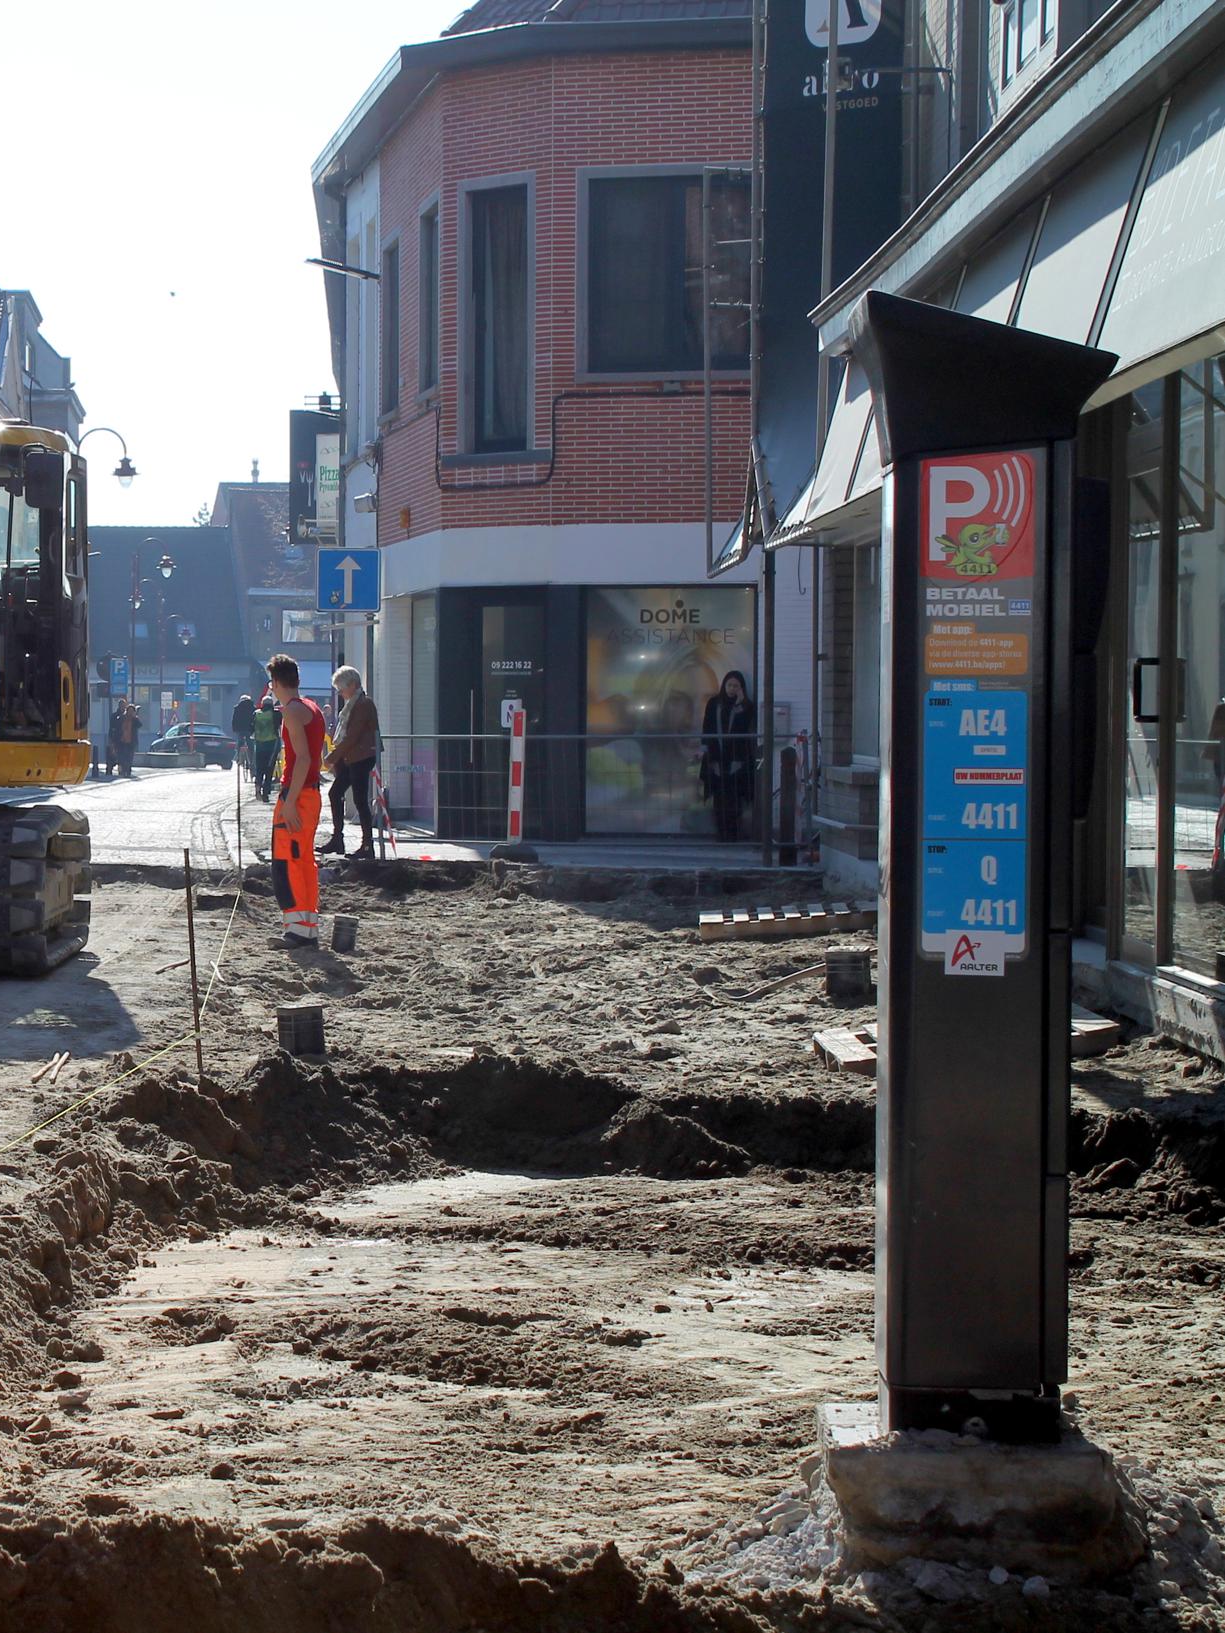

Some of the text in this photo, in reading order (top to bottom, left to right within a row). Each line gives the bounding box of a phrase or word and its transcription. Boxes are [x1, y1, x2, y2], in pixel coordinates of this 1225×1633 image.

[821, 97, 879, 112] VSTGOED
[960, 564, 993, 574] 4411
[926, 587, 1005, 600] BETAAL
[639, 608, 701, 624] DOME
[926, 604, 1007, 617] MOBIEL
[607, 627, 737, 645] ASSISTANCE
[959, 709, 1007, 736] AE4
[969, 772, 1023, 780] NUMMERPLAAT
[961, 803, 1017, 829] 4411
[980, 855, 998, 885] Q
[960, 898, 1016, 926] 4411
[959, 963, 999, 972] AALTER
